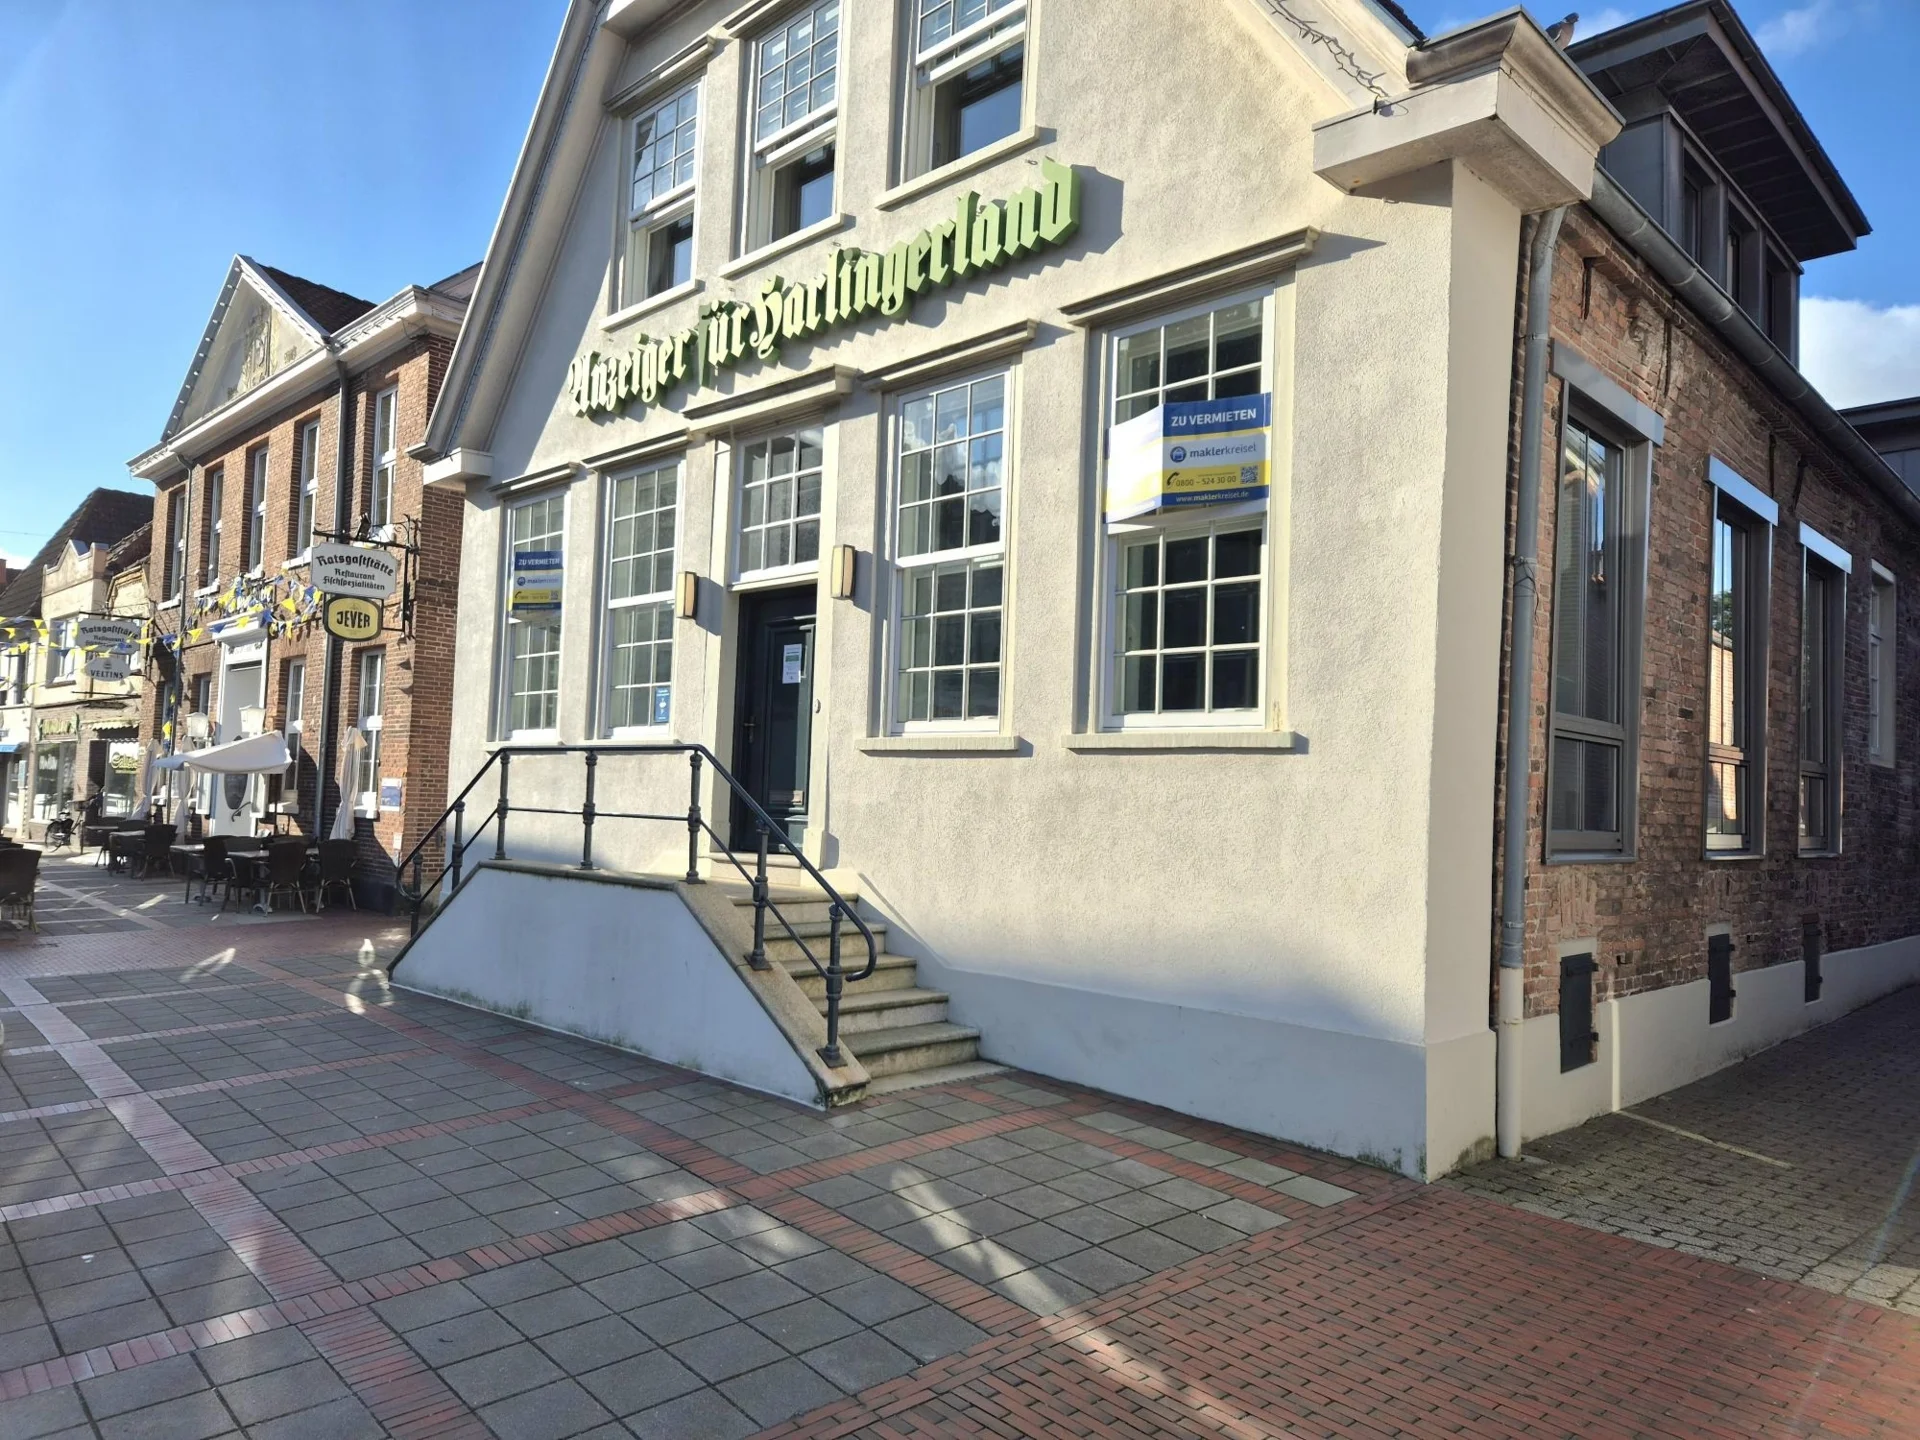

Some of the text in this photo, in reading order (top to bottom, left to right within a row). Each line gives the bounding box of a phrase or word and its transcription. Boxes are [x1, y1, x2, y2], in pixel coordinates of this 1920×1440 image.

[568, 156, 1081, 417] Anzeiger für Harlingerland
[1171, 408, 1257, 427] ZU VERMIETEN
[1190, 442, 1257, 458] maklerkreisel
[336, 610, 371, 629] JEVER
[90, 669, 124, 679] VELTINS
